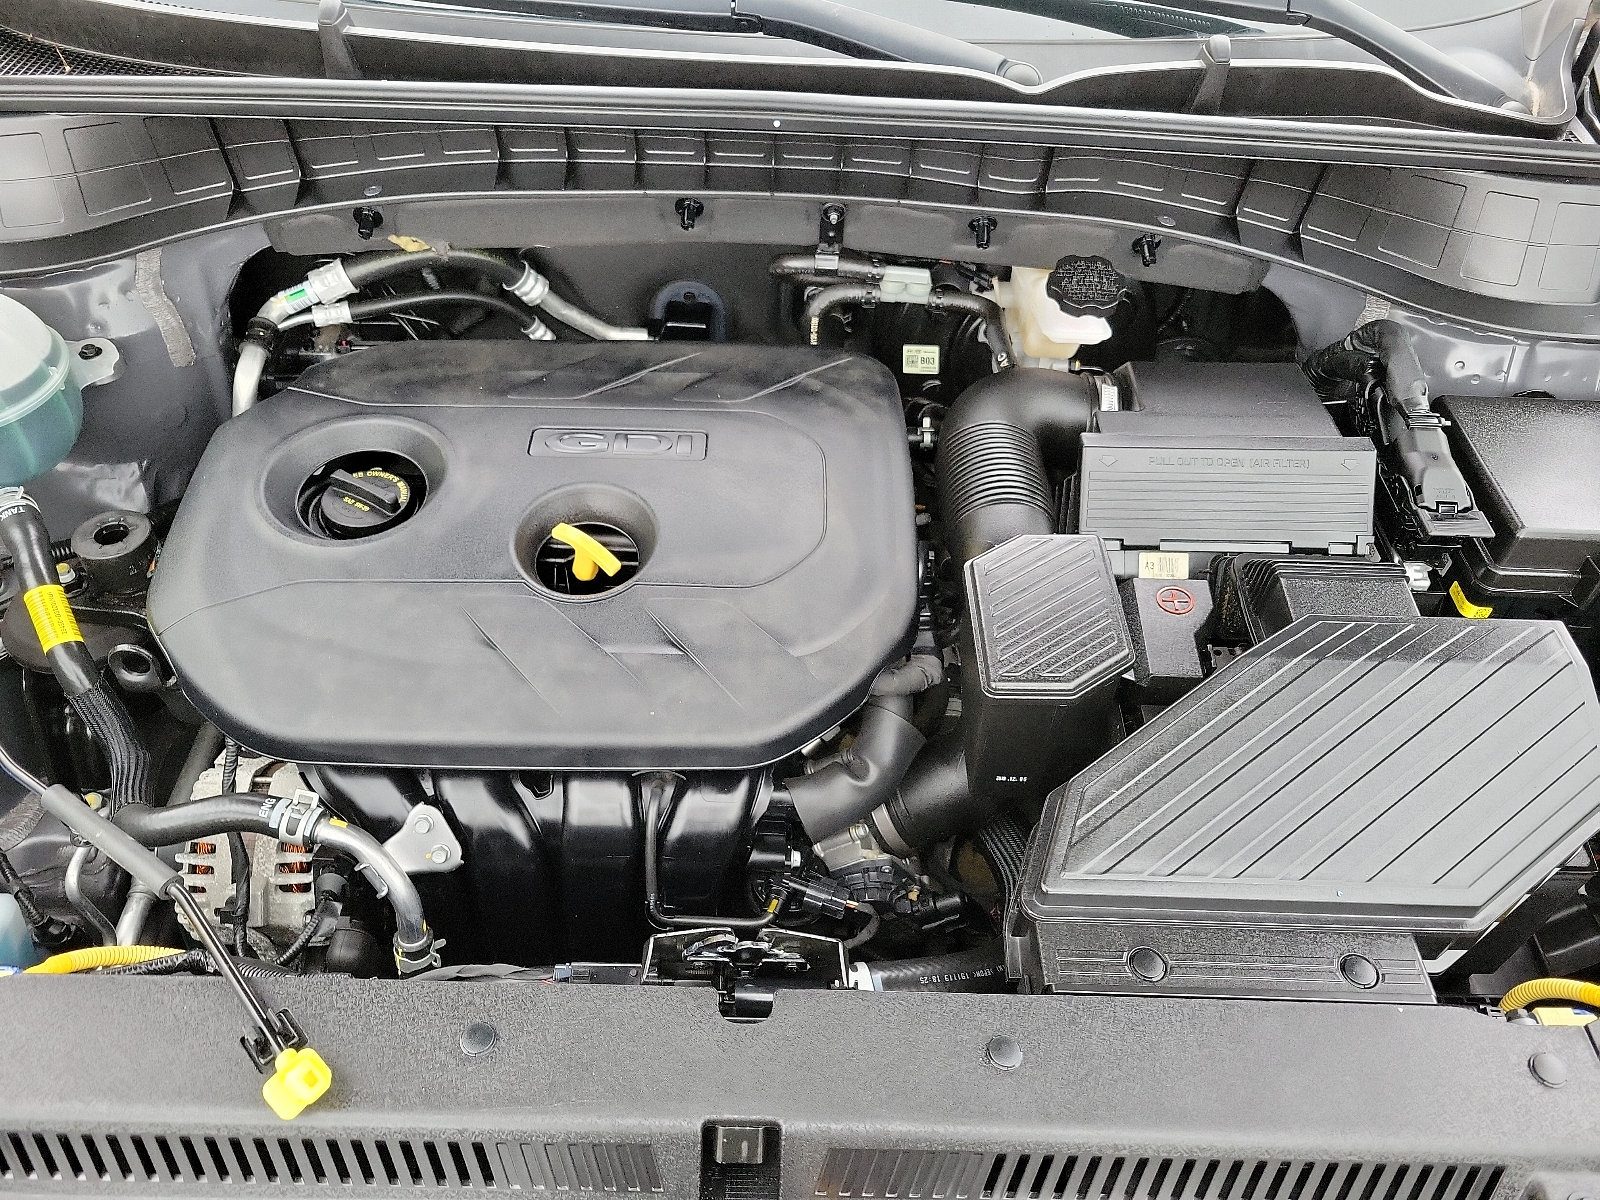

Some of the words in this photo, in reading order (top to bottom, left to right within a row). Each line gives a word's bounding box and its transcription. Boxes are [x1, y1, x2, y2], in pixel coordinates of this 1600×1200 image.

[920, 357, 935, 365] B03
[545, 432, 693, 457] GDI
[1148, 456, 1175, 466] PULL
[1176, 457, 1198, 467] OUT
[1200, 457, 1213, 467] TO
[1216, 457, 1245, 468] OPEN
[1144, 561, 1155, 570] A3
[258, 797, 277, 819] ENG
[919, 974, 941, 984] 18:25
